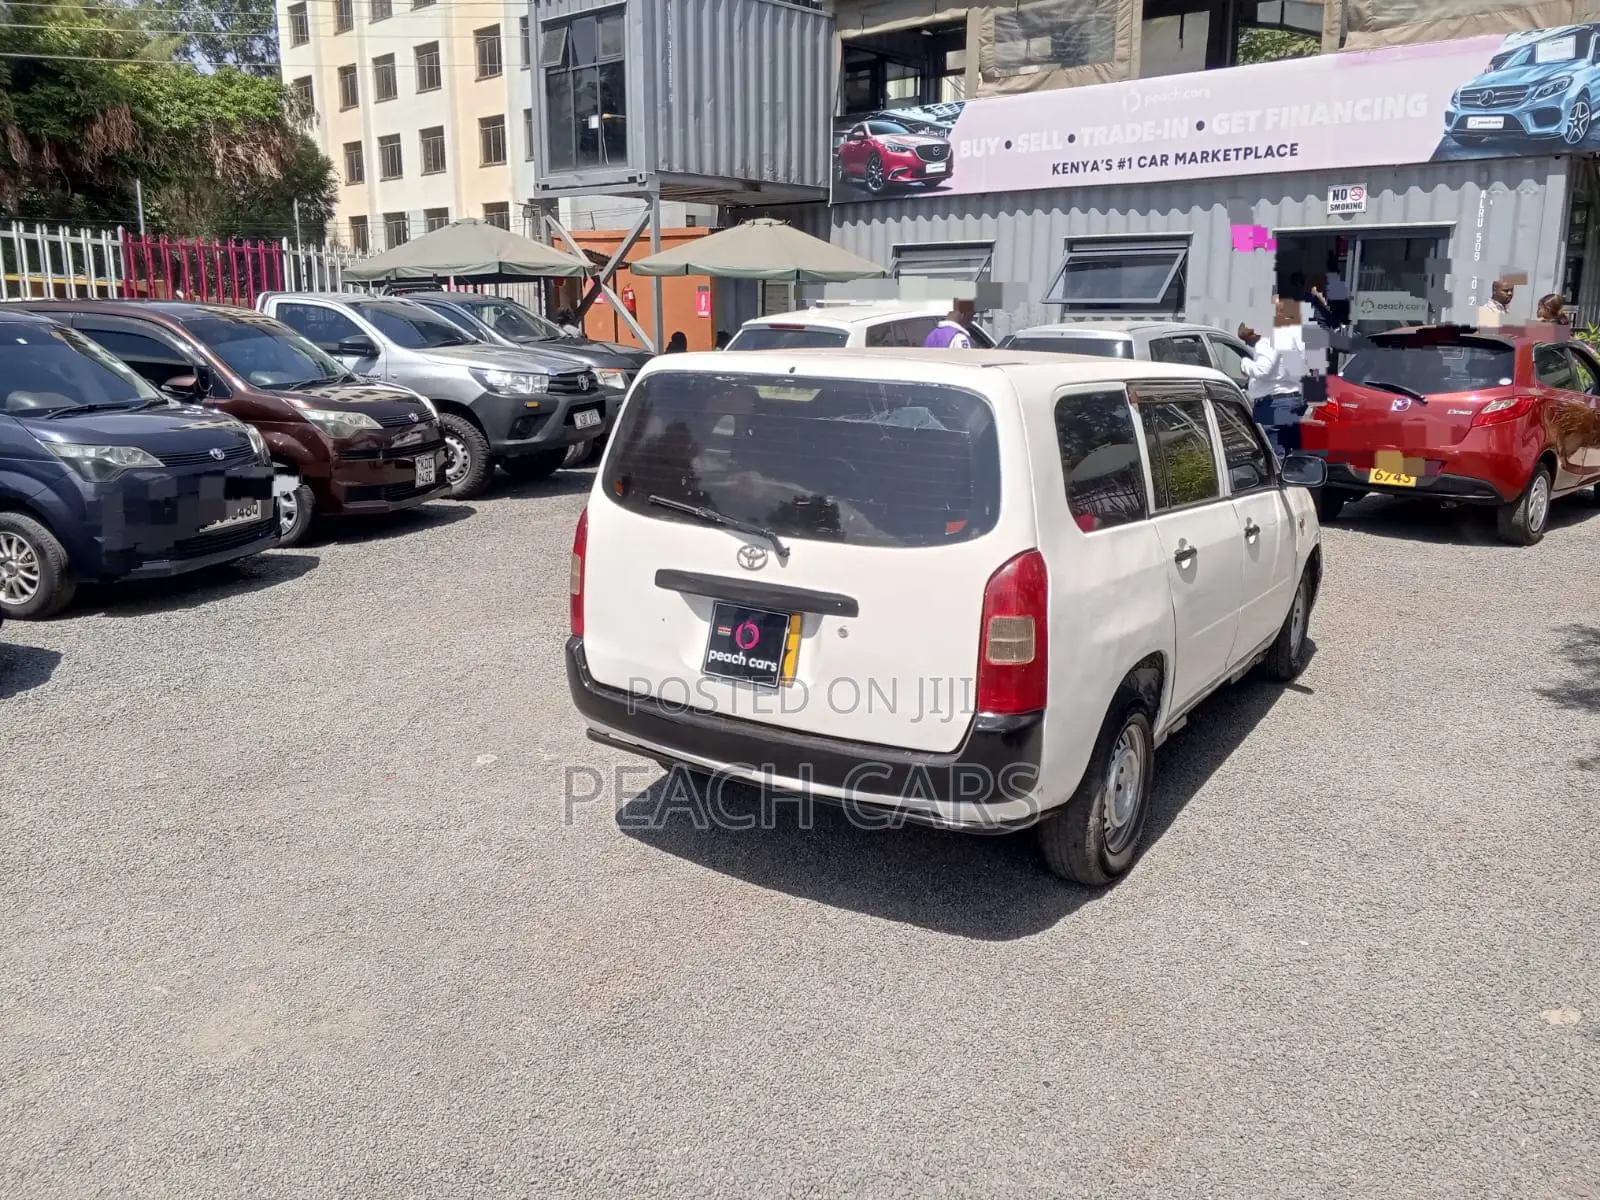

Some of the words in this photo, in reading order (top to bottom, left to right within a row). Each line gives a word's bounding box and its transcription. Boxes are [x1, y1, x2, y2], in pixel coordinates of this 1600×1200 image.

[959, 136, 1001, 159] BUY
[1017, 130, 1063, 154] SELL
[1081, 115, 1190, 148] TRADE-IN
[1211, 109, 1262, 136] GET
[1263, 92, 1429, 131] FINANCING
[1051, 159, 1114, 176] KENYA'S
[1117, 156, 1133, 171] #1
[1138, 154, 1170, 168] CAR
[1174, 142, 1300, 166] MARKETPLACE
[1329, 201, 1364, 211] SMOKING
[1332, 188, 1348, 201] NO
[707, 649, 747, 666] peach
[748, 656, 778, 672] cars
